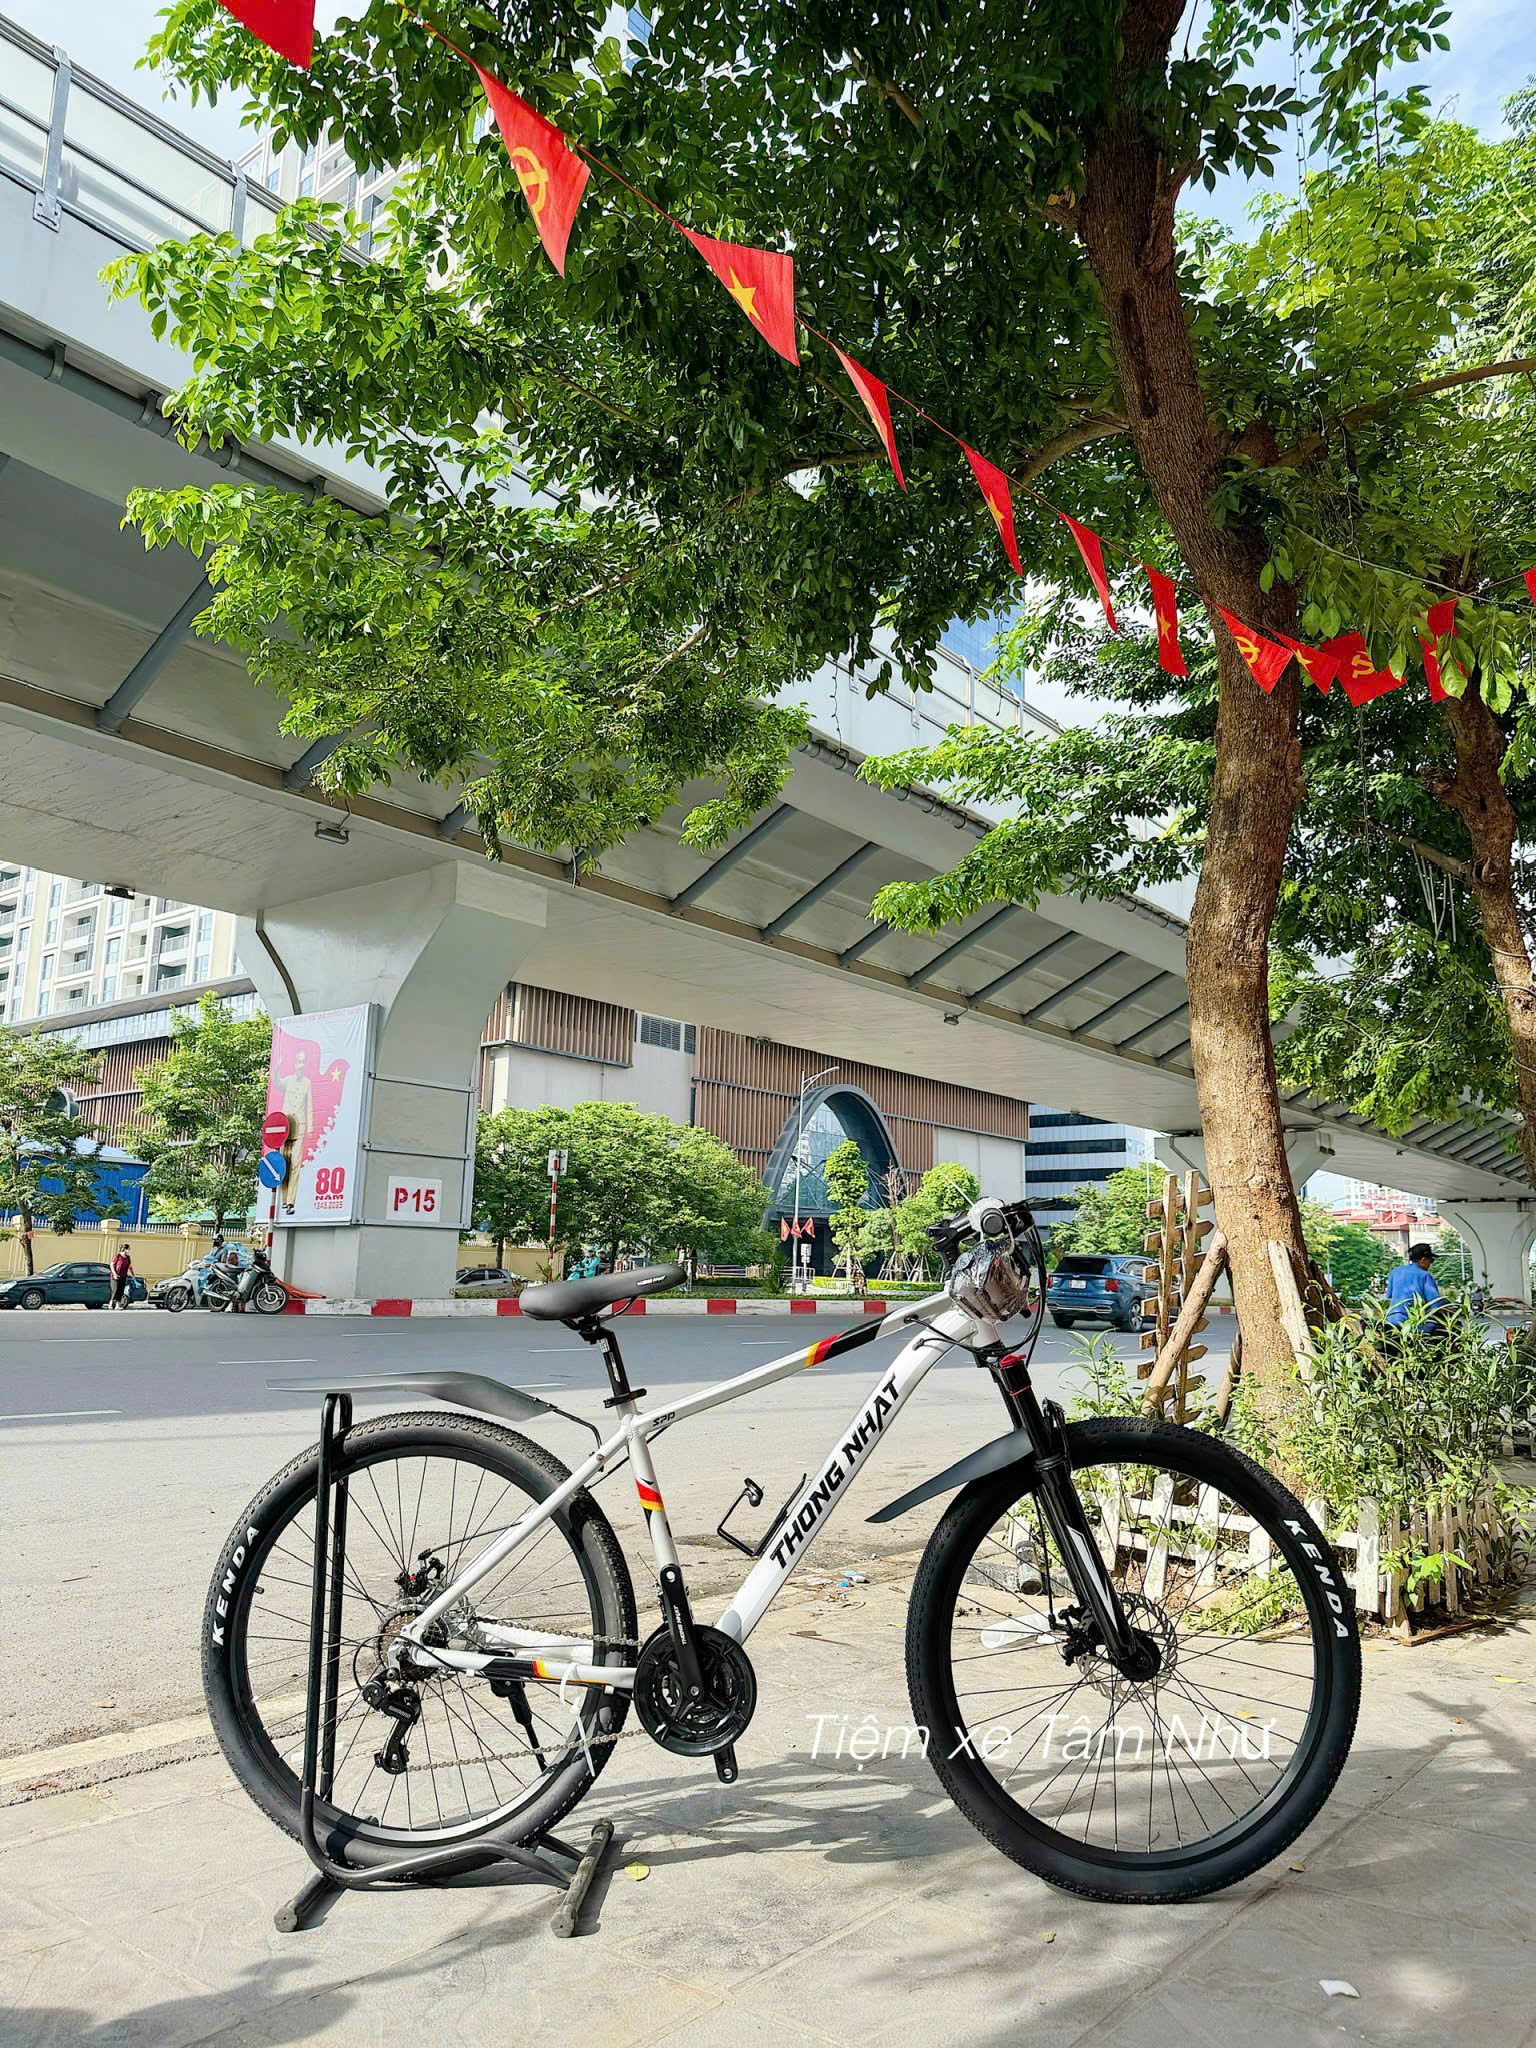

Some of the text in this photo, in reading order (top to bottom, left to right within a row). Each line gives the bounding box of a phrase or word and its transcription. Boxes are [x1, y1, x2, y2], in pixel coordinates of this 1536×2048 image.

[315, 1167, 345, 1195] 80
[393, 1187, 436, 1213] P15
[770, 1372, 899, 1570] THONG NHAT
[212, 1526, 260, 1646] KENDA
[1283, 1519, 1349, 1638] KENDA
